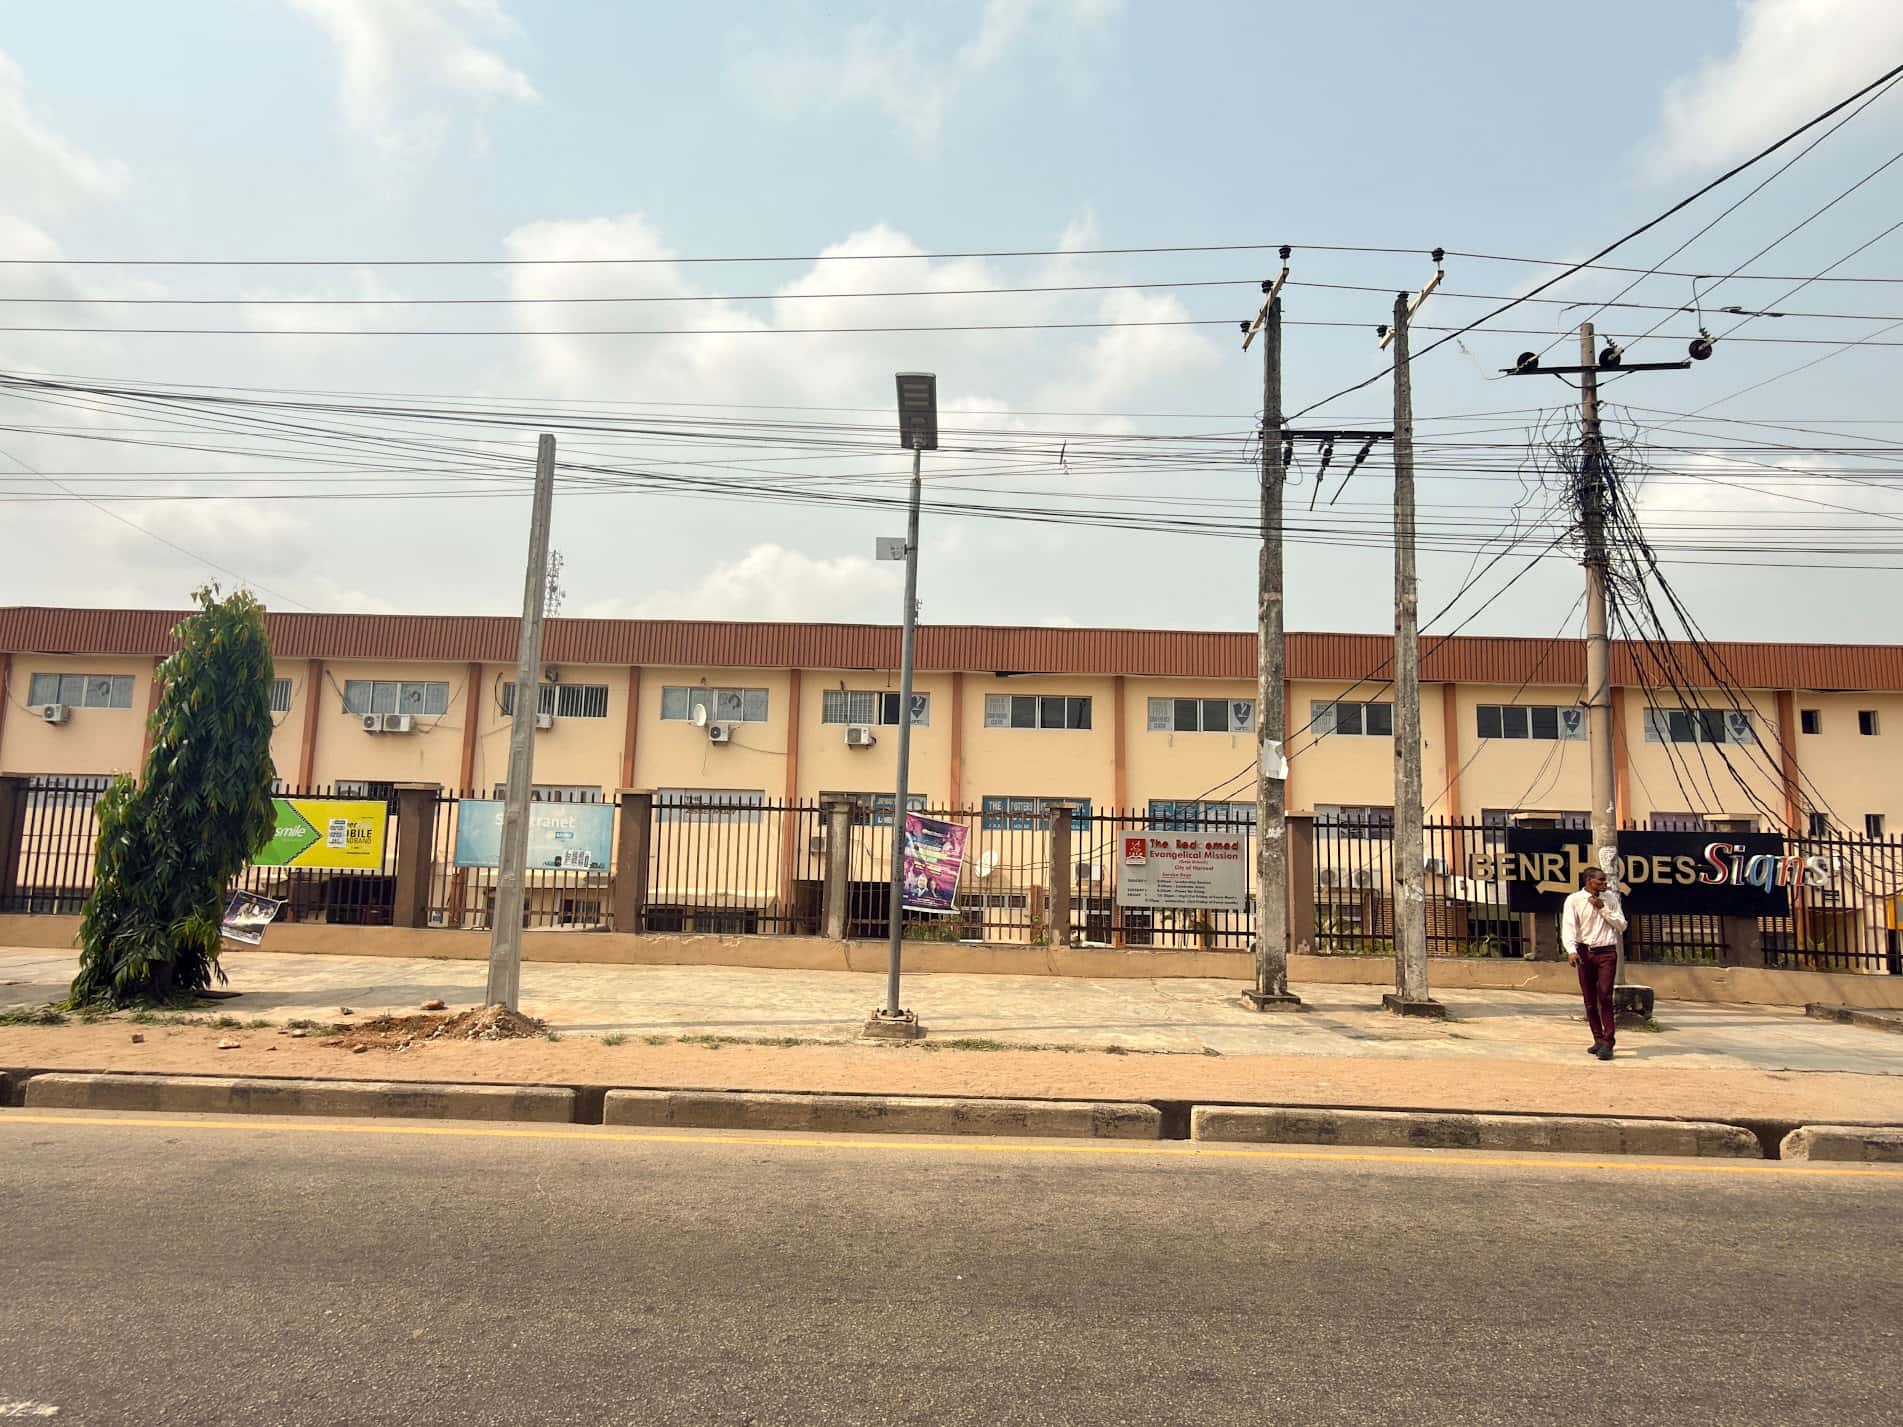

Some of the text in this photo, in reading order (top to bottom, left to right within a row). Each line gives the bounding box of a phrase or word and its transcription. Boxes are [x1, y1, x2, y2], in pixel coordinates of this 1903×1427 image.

[274, 824, 307, 838] smile
[1149, 838, 1169, 849] The
[1149, 849, 1202, 861] Evangelical
[1203, 850, 1239, 861] Mission
